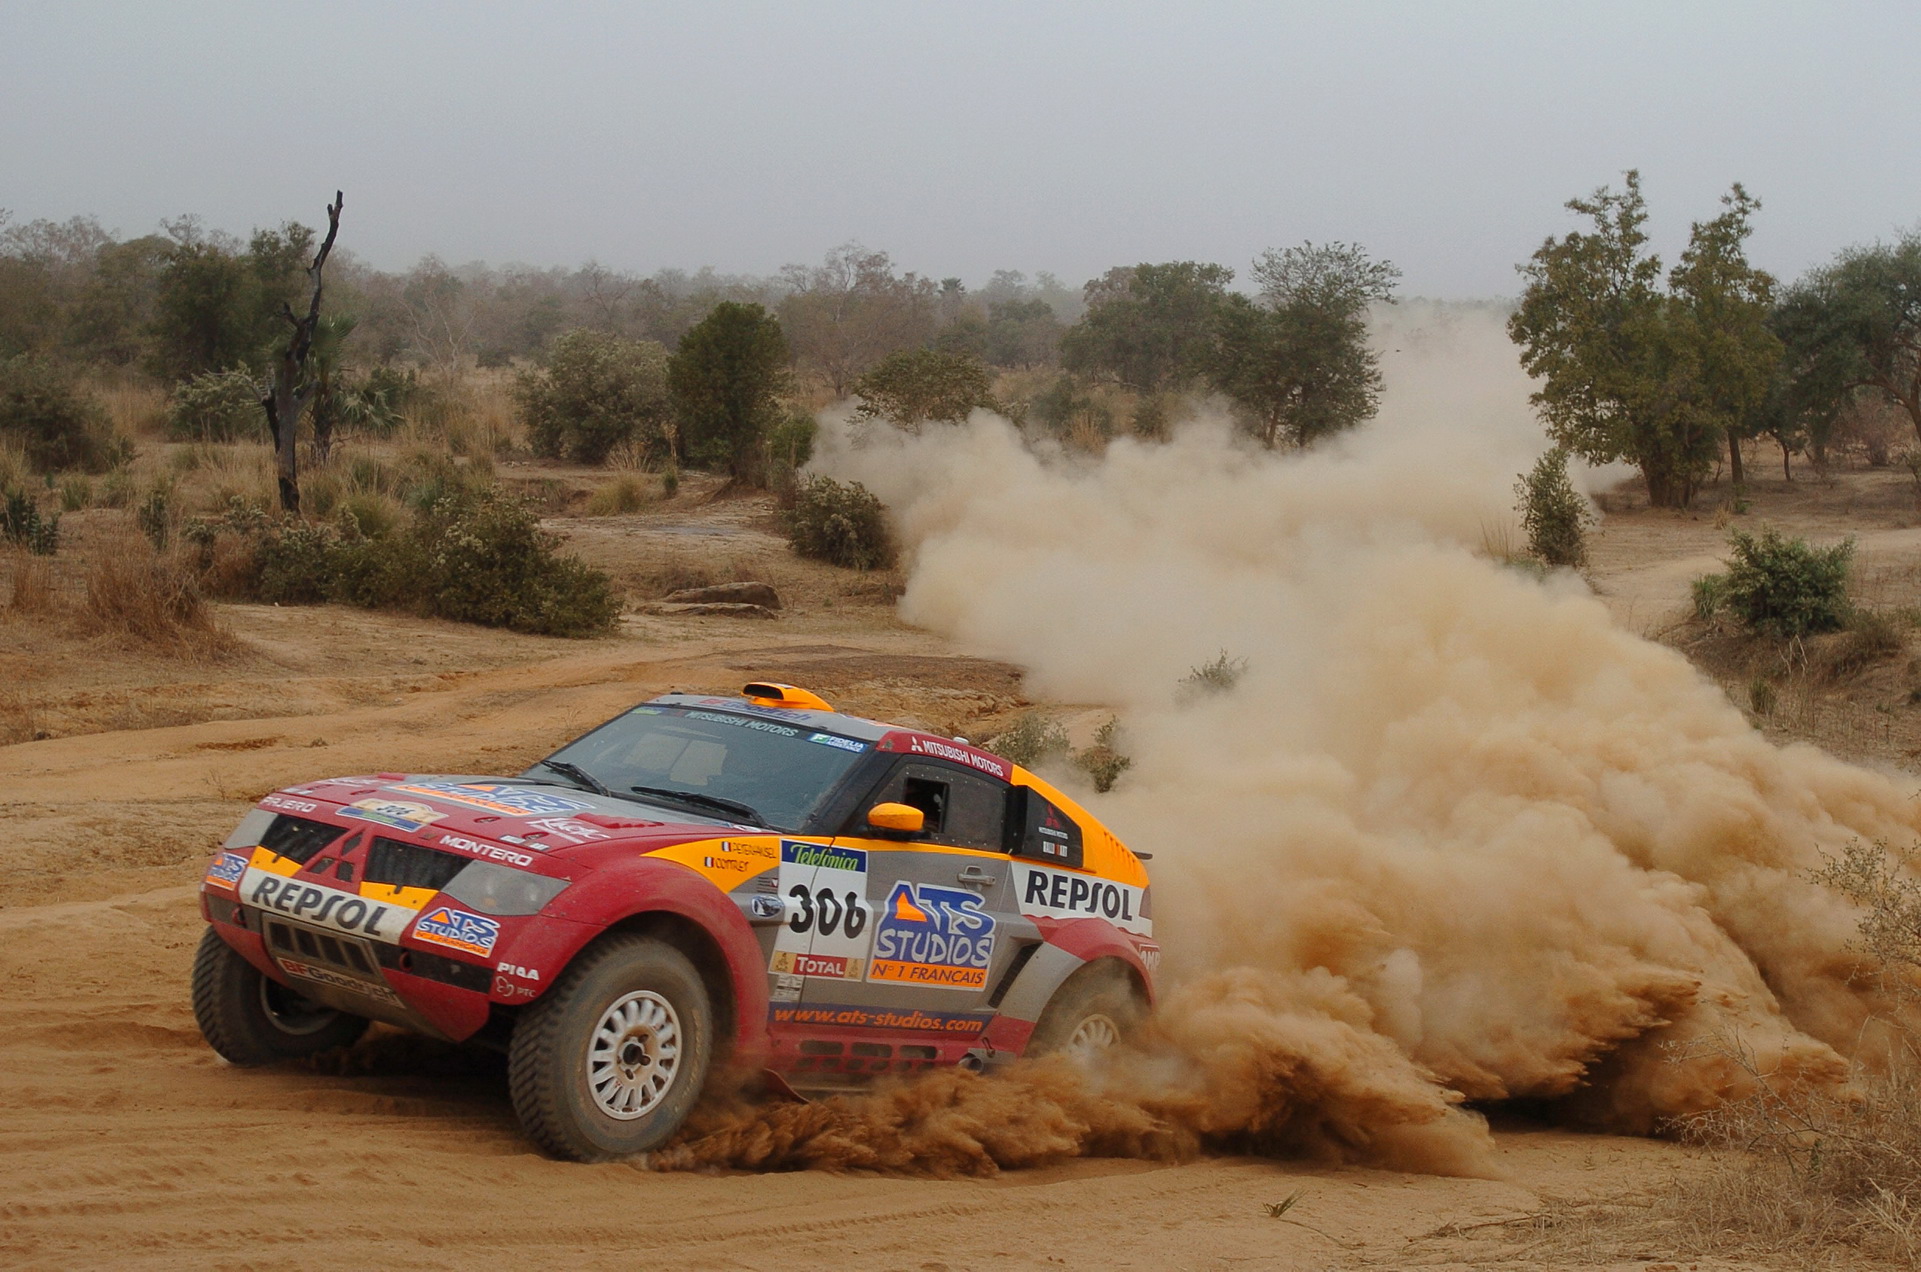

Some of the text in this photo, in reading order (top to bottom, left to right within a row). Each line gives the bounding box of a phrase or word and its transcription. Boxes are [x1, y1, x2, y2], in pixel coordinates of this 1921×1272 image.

[684, 710, 745, 727] MITSUBISHI
[747, 719, 799, 737] MOTORS
[923, 740, 1004, 777] MITSUBISHI MOTORS
[262, 796, 317, 813] PAJERO
[439, 834, 534, 867] MONTERO
[251, 875, 390, 937] REPSOL
[787, 883, 867, 939] 306
[880, 881, 996, 939] ATS
[1024, 869, 1133, 922] REPSOL
[416, 920, 496, 949] STUDIOS
[418, 906, 500, 938] ATS
[875, 928, 993, 967] STUDIOS
[496, 961, 540, 981] PIAA
[898, 965, 906, 979] 1
[516, 986, 537, 998] PTC
[773, 1005, 983, 1033] www.ats-studios.com
